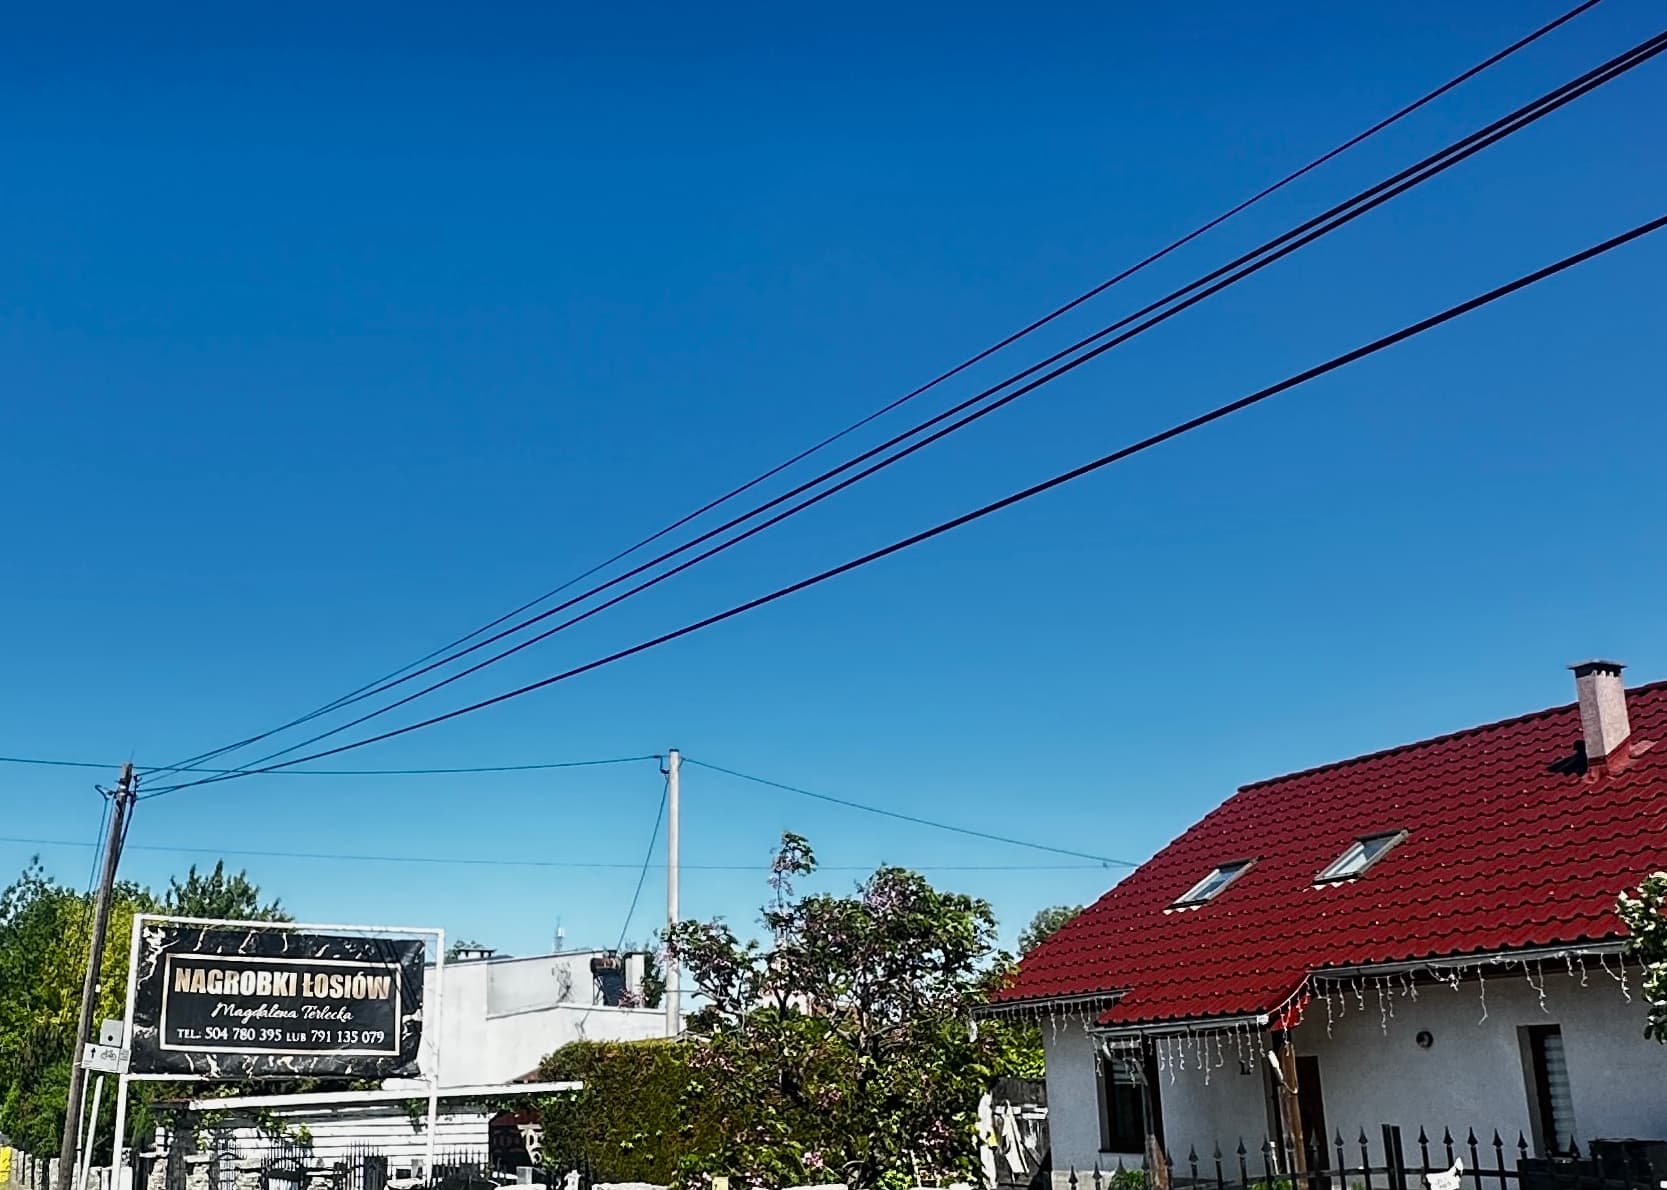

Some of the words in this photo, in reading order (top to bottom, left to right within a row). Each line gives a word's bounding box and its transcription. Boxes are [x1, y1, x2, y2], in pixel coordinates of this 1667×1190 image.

[174, 967, 298, 997] NAGROBKI
[301, 971, 391, 1000] ŁOSIÓW
[210, 1001, 299, 1024] Magdalena
[301, 1004, 354, 1023] Terlecka
[204, 1026, 228, 1040] 504
[232, 1027, 256, 1041] 780
[259, 1028, 282, 1042] 395
[286, 1031, 307, 1042] LUB
[310, 1029, 331, 1043] 791
[337, 1030, 359, 1043] 135
[361, 1030, 385, 1044] 079
